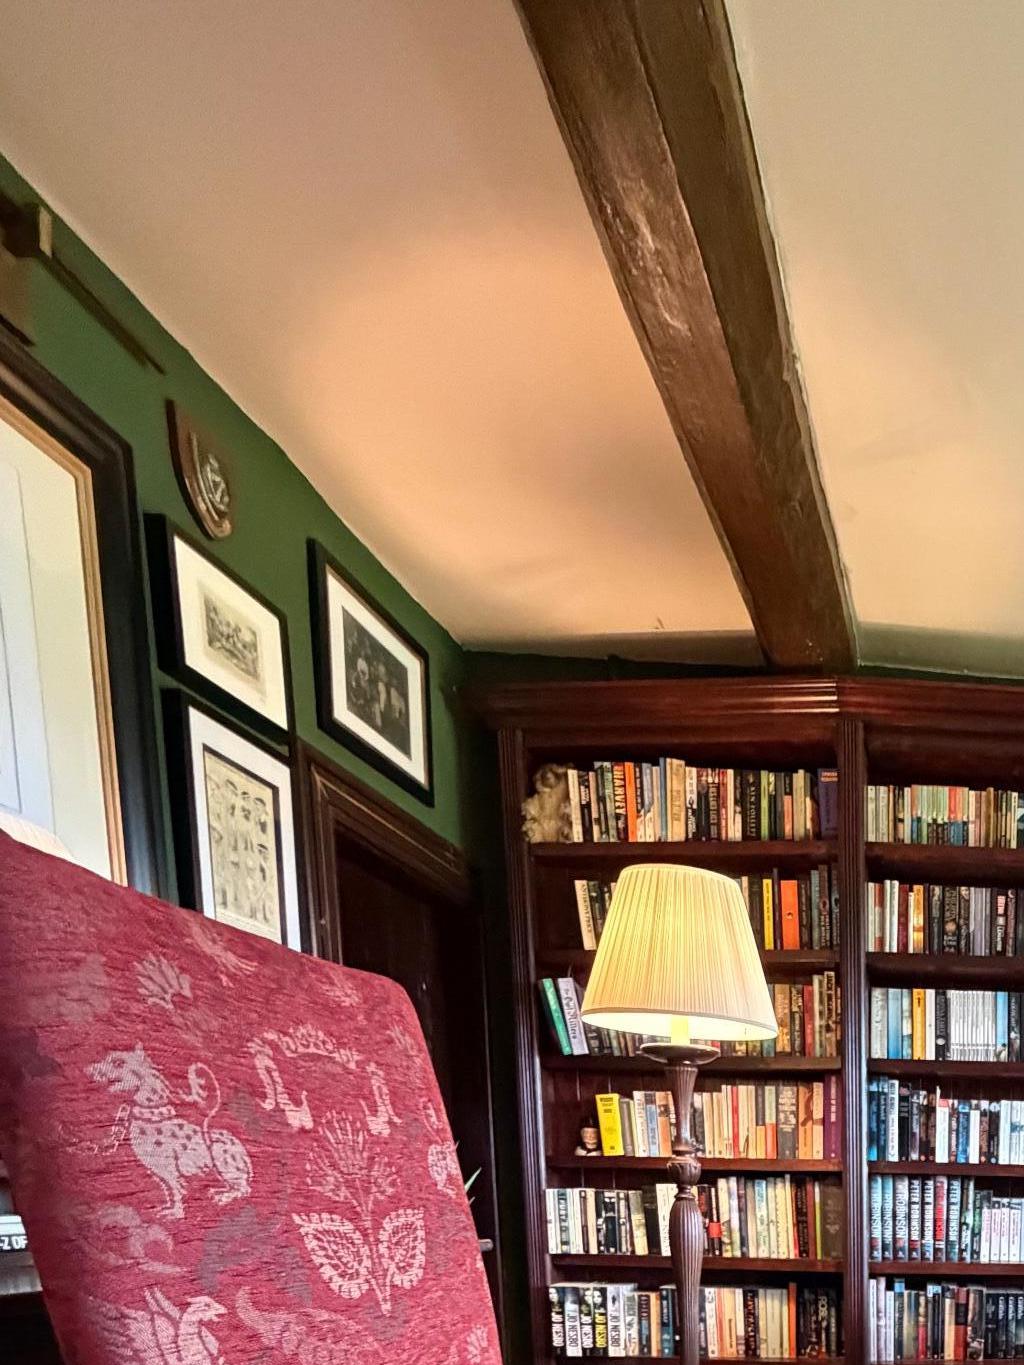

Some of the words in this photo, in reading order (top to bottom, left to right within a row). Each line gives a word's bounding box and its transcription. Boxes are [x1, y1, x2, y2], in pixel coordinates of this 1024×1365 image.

[910, 1180, 920, 1203] PETER
[923, 1181, 932, 1203] PETER
[949, 1181, 958, 1203] PETER
[896, 1193, 906, 1238] ROBINSON
[910, 1205, 920, 1240] ROBINSON
[923, 1205, 932, 1240] ROBINSON
[949, 1205, 959, 1241] ROBINSON
[567, 1314, 577, 1323] JO
[594, 1314, 605, 1323] JO
[610, 1314, 620, 1322] JO
